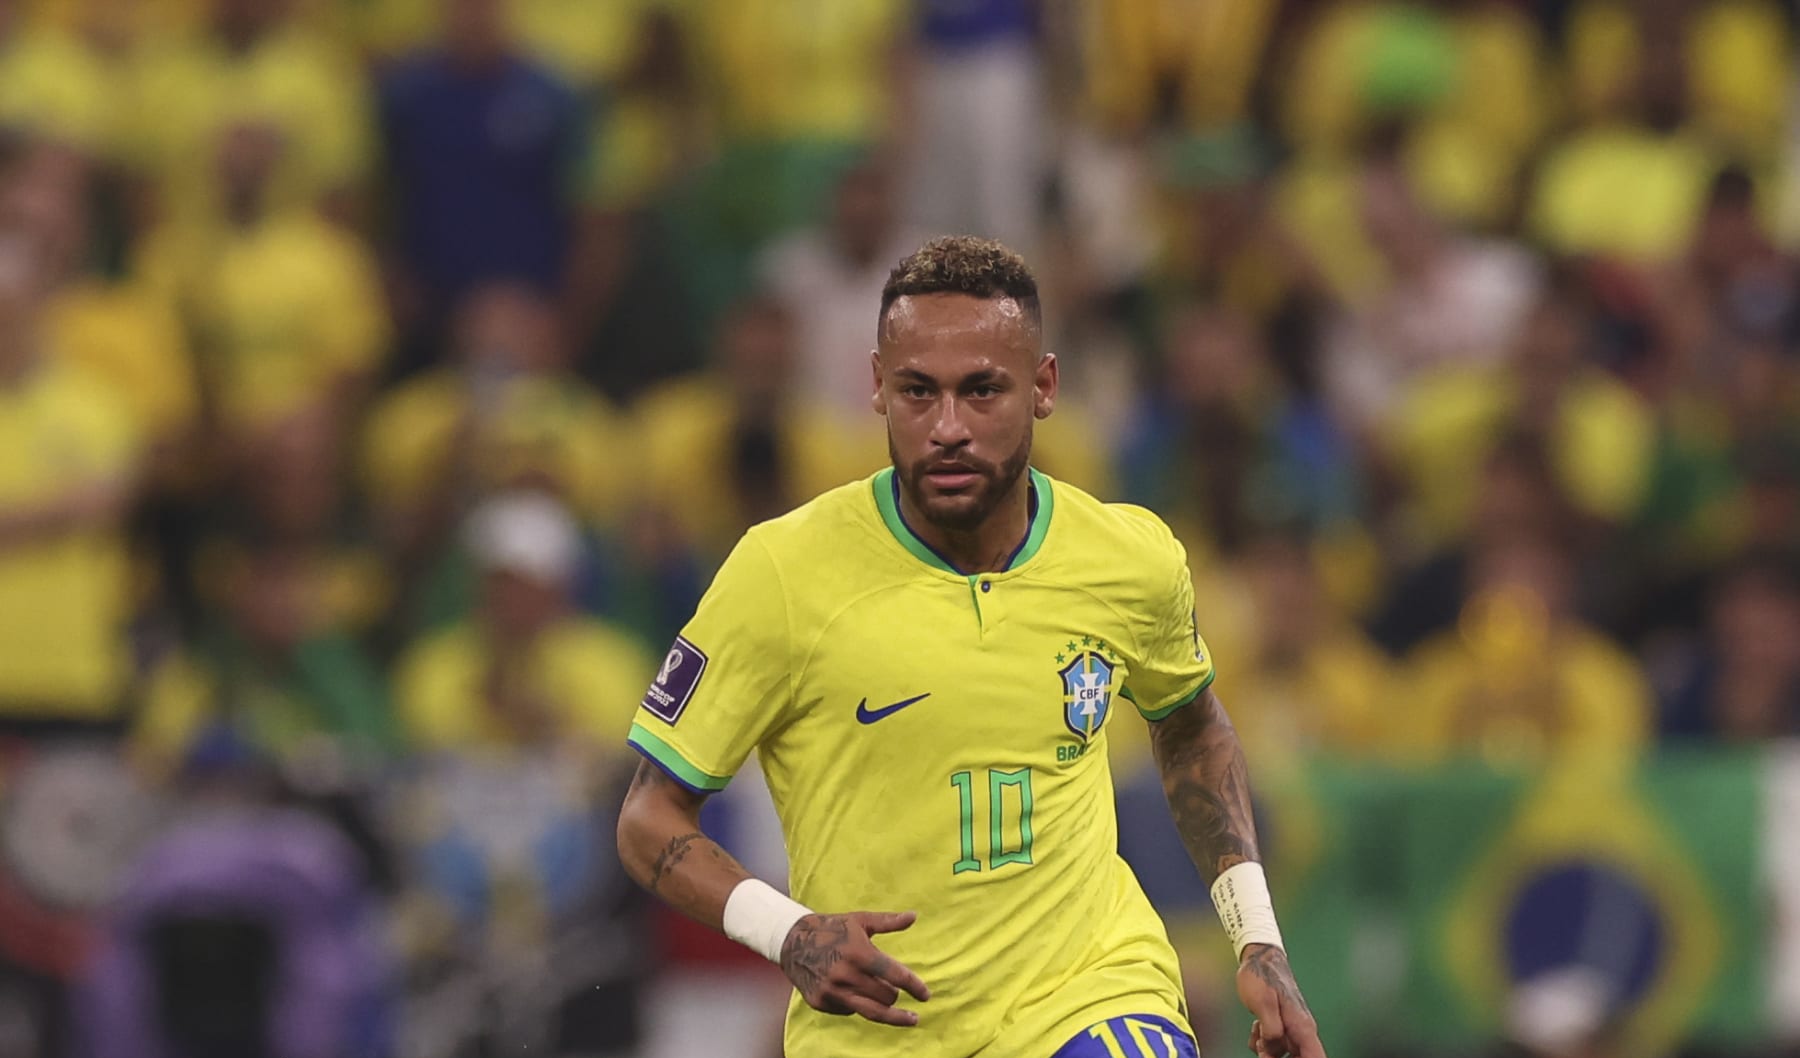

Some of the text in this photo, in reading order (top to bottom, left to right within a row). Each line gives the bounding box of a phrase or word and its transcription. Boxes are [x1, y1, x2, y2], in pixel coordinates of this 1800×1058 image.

[1079, 687, 1100, 700] CBF
[1056, 744, 1088, 762] BRA
[951, 767, 1034, 875] 10
